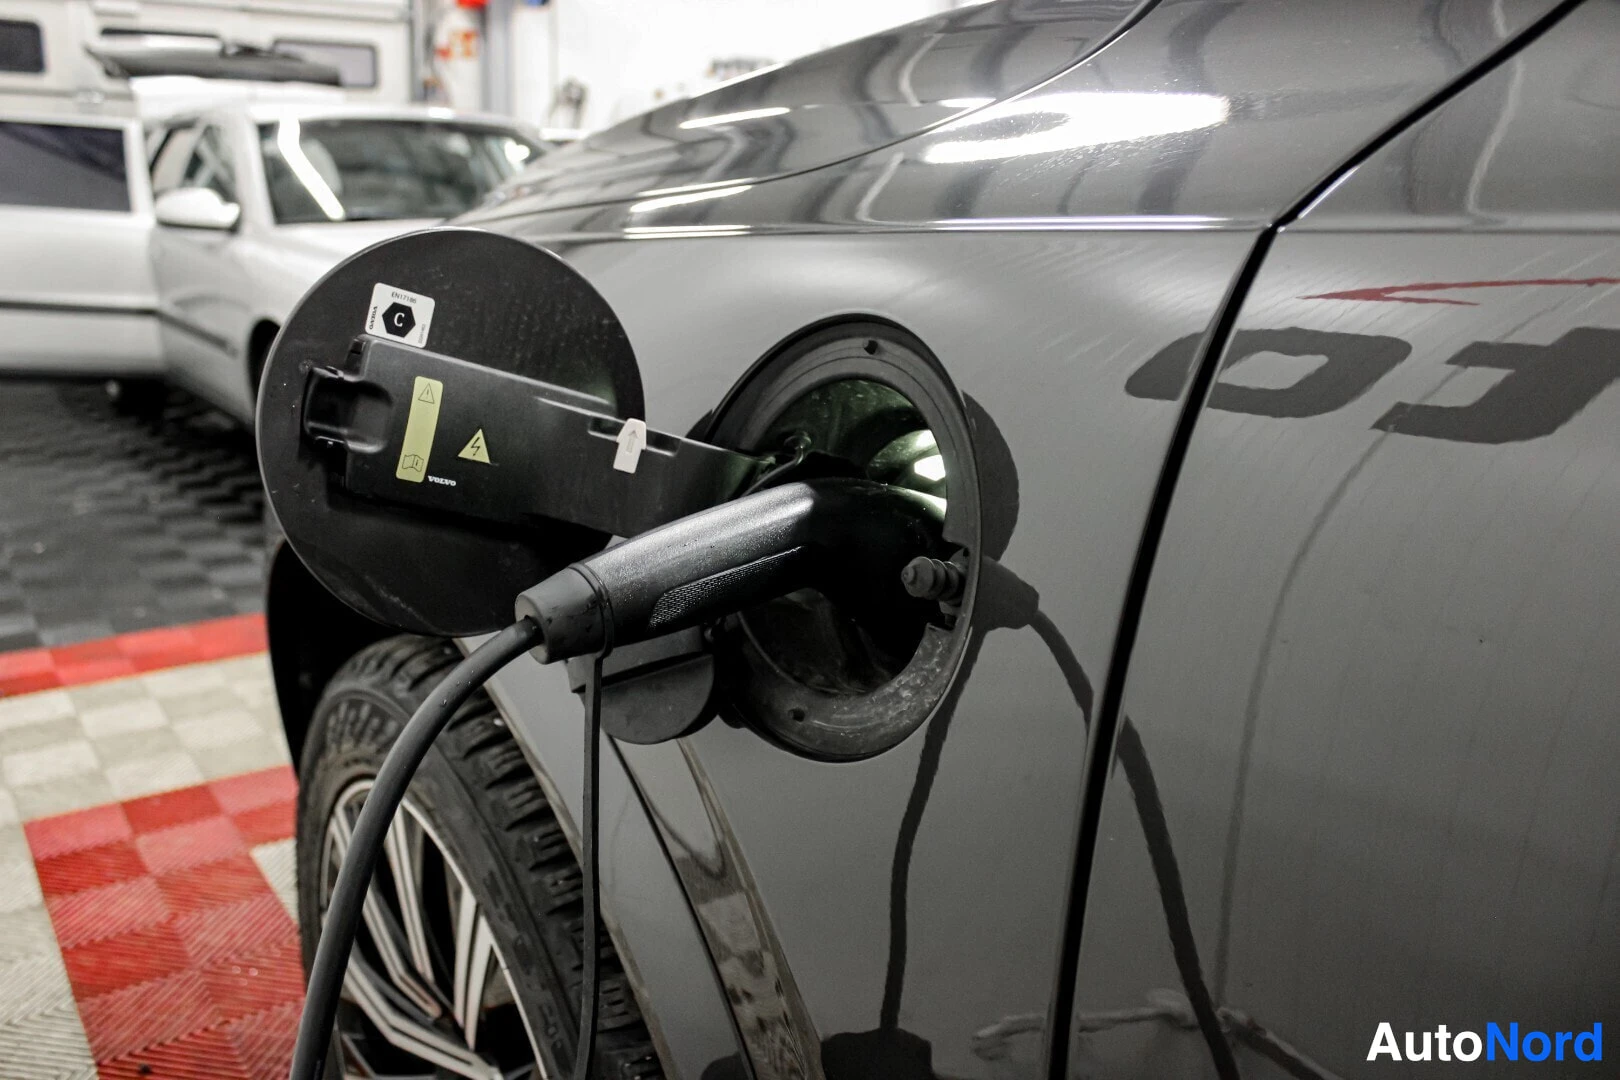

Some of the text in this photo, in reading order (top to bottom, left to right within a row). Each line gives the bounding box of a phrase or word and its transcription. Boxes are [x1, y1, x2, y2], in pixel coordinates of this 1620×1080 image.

[369, 305, 378, 330] VOLVO
[394, 312, 405, 327] C
[428, 475, 457, 487] VOLVO
